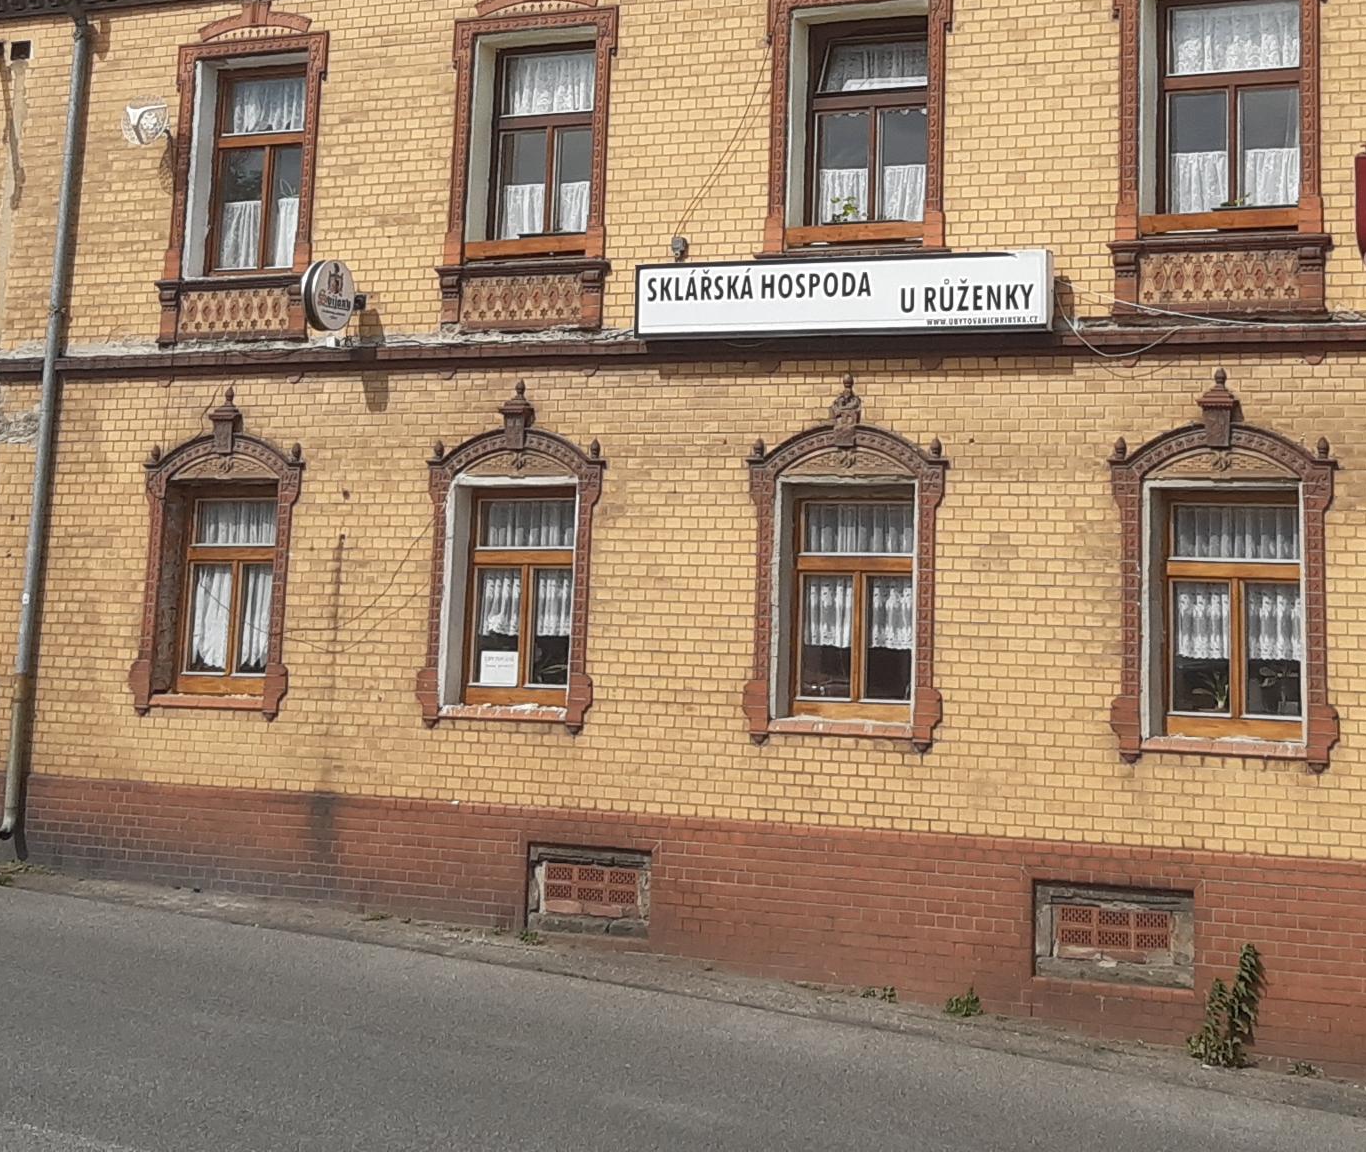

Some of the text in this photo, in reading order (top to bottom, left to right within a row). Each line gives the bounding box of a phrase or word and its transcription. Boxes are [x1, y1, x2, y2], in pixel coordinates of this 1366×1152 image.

[647, 268, 871, 302] SKLÁŘSKÁ HOSPODA
[900, 278, 1034, 313] U RŮŽENKY
